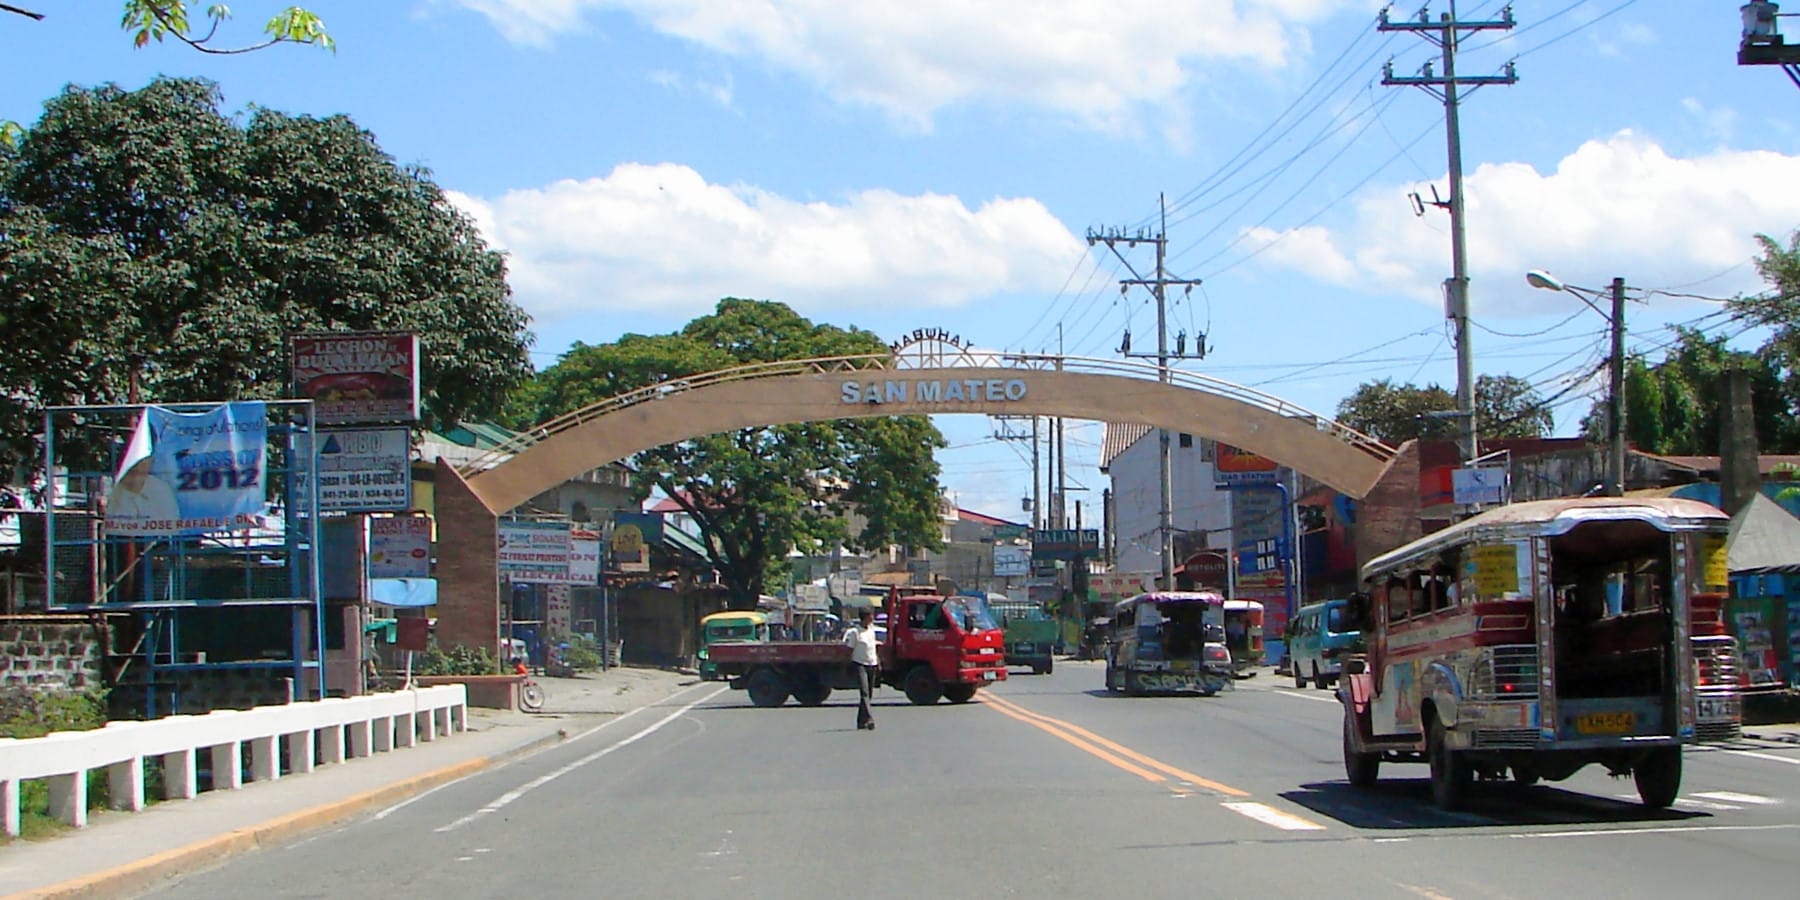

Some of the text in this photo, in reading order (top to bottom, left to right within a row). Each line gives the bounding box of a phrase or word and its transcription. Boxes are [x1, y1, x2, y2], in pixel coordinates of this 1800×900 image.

[314, 340, 388, 355] LECHON
[889, 327, 974, 355] MABUHAY
[841, 379, 1027, 404] SAN MATEO
[177, 468, 260, 491] 2012
[142, 519, 173, 531] JOSE
[175, 517, 221, 530] RAFAEL
[513, 570, 595, 582] ELECTRICAL
